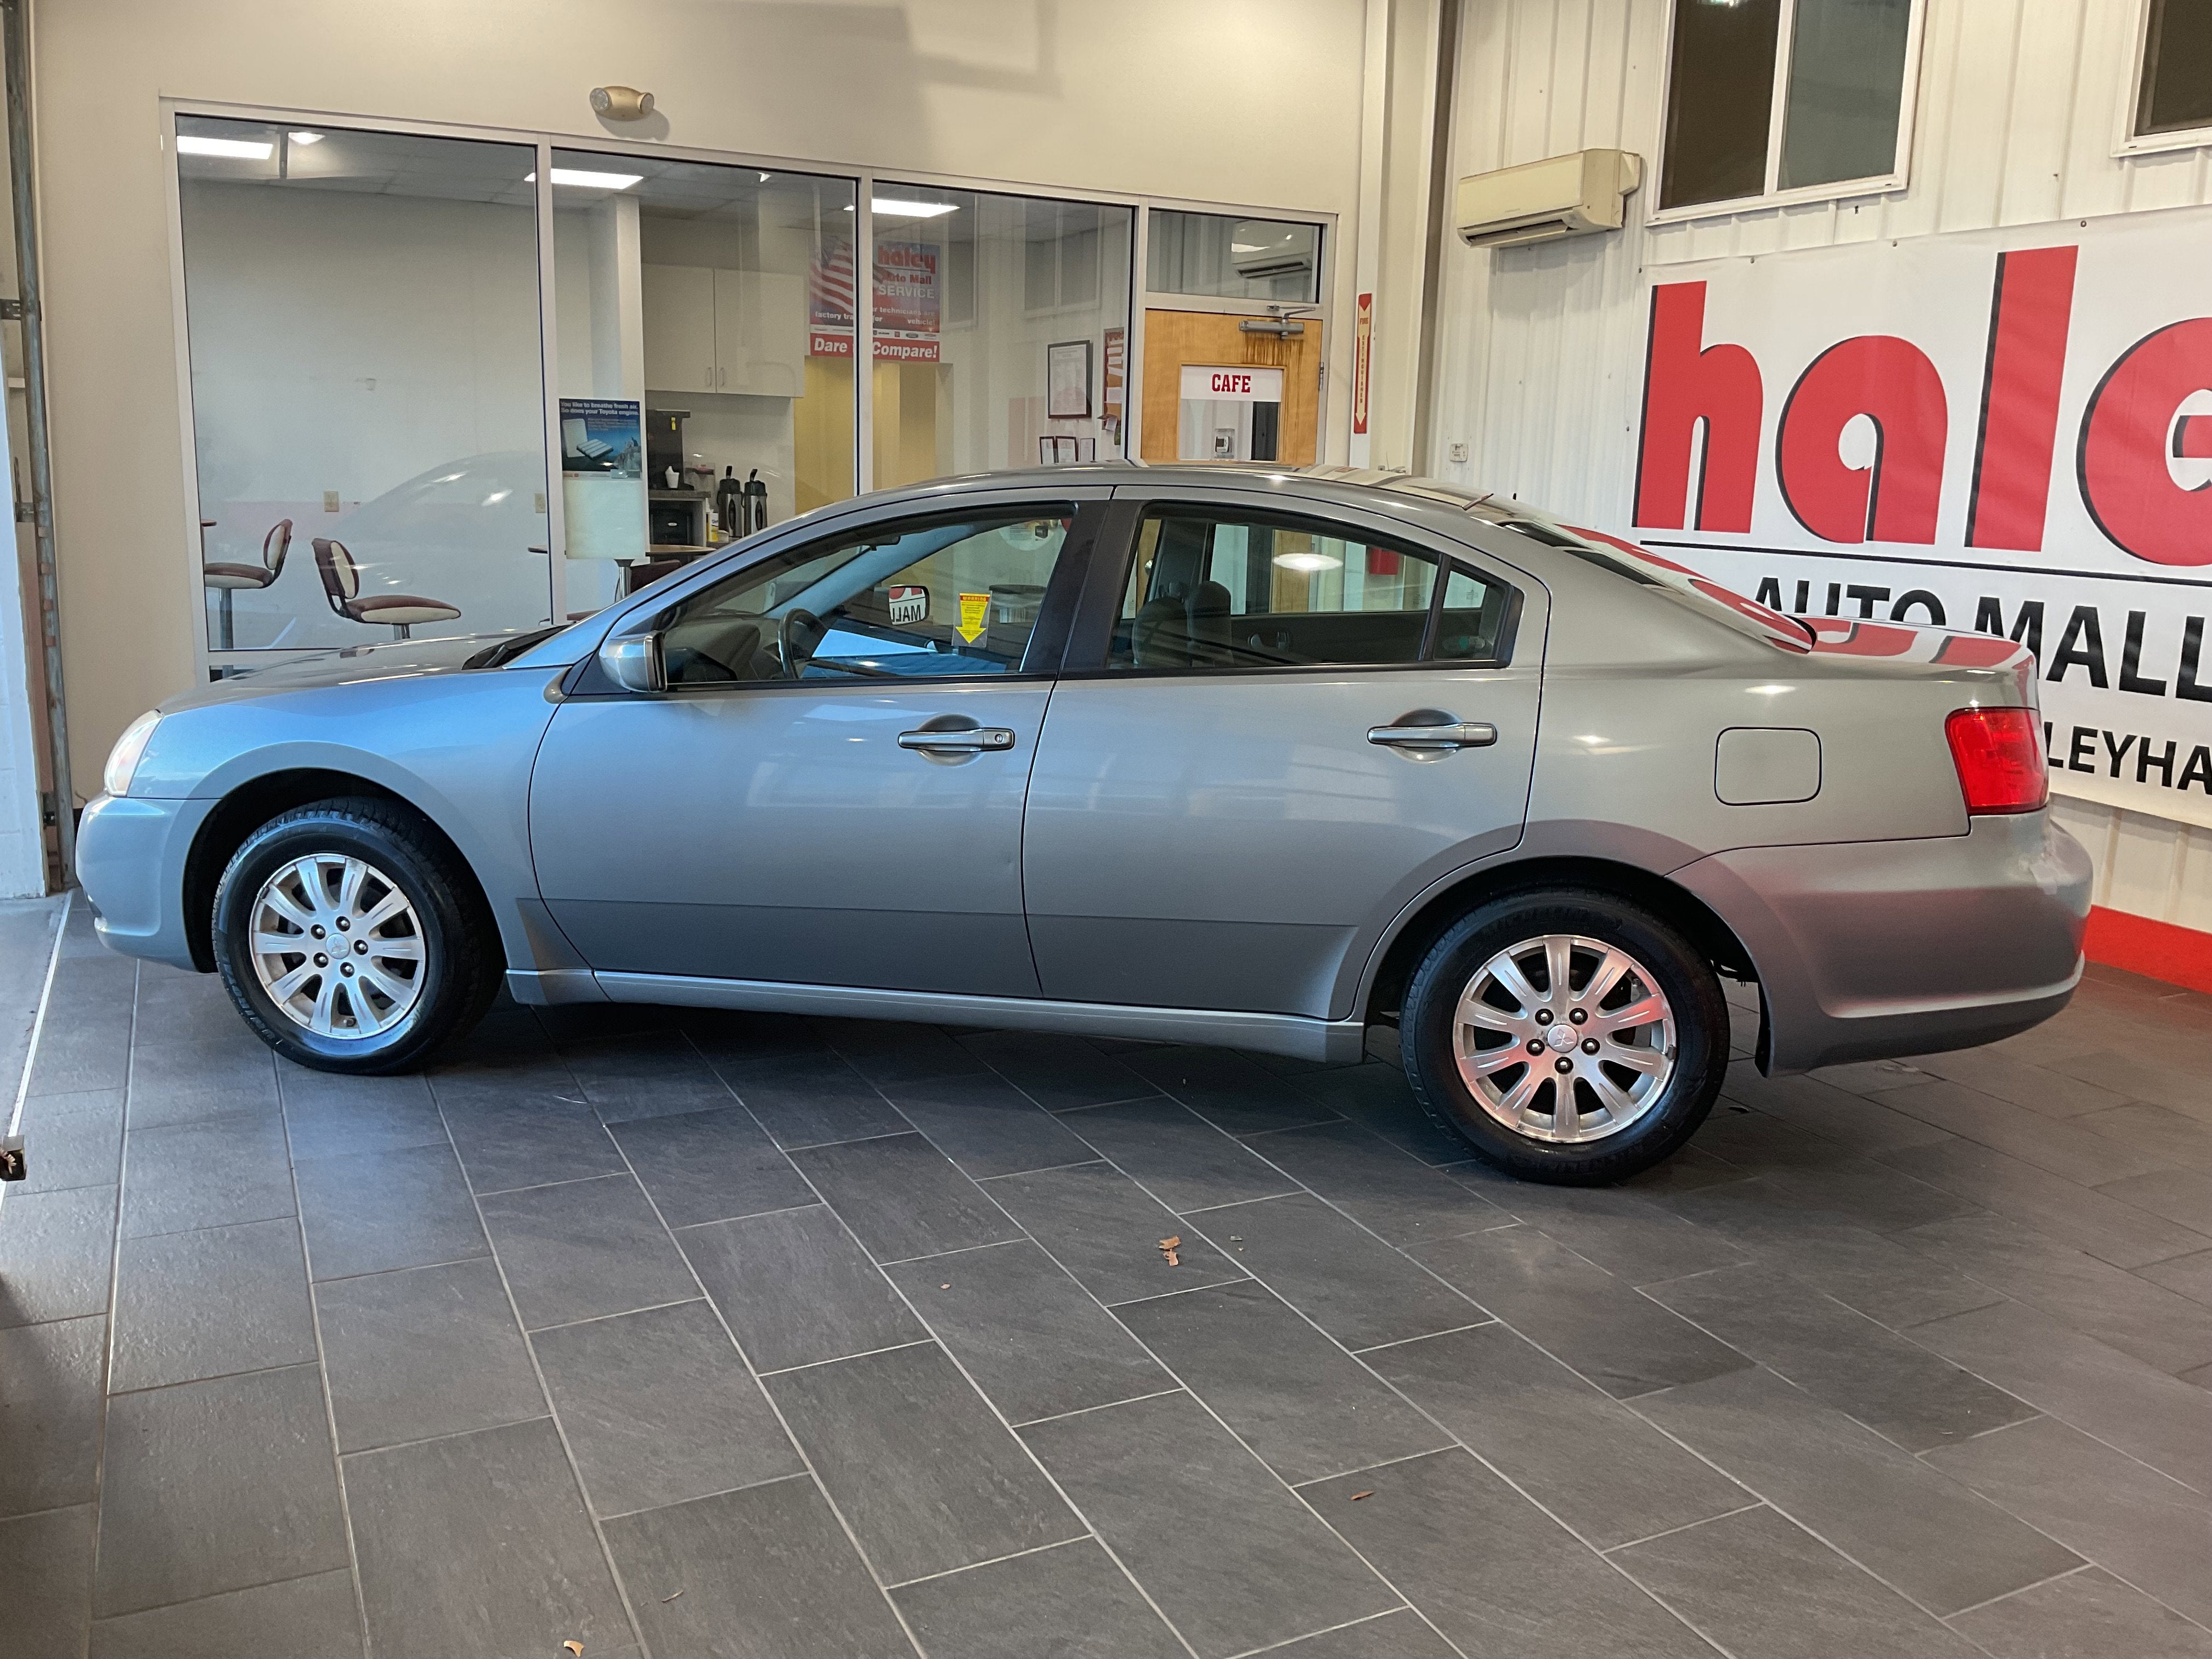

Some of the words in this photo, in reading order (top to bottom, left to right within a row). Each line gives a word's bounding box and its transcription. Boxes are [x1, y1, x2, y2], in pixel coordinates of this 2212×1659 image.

[910, 275, 932, 284] Mall
[878, 285, 935, 298] SERVICE
[815, 311, 842, 320] factory
[880, 307, 922, 317] technicians
[815, 337, 847, 352] Dare
[873, 341, 938, 358] Compare!
[1212, 374, 1251, 393] CAFE
